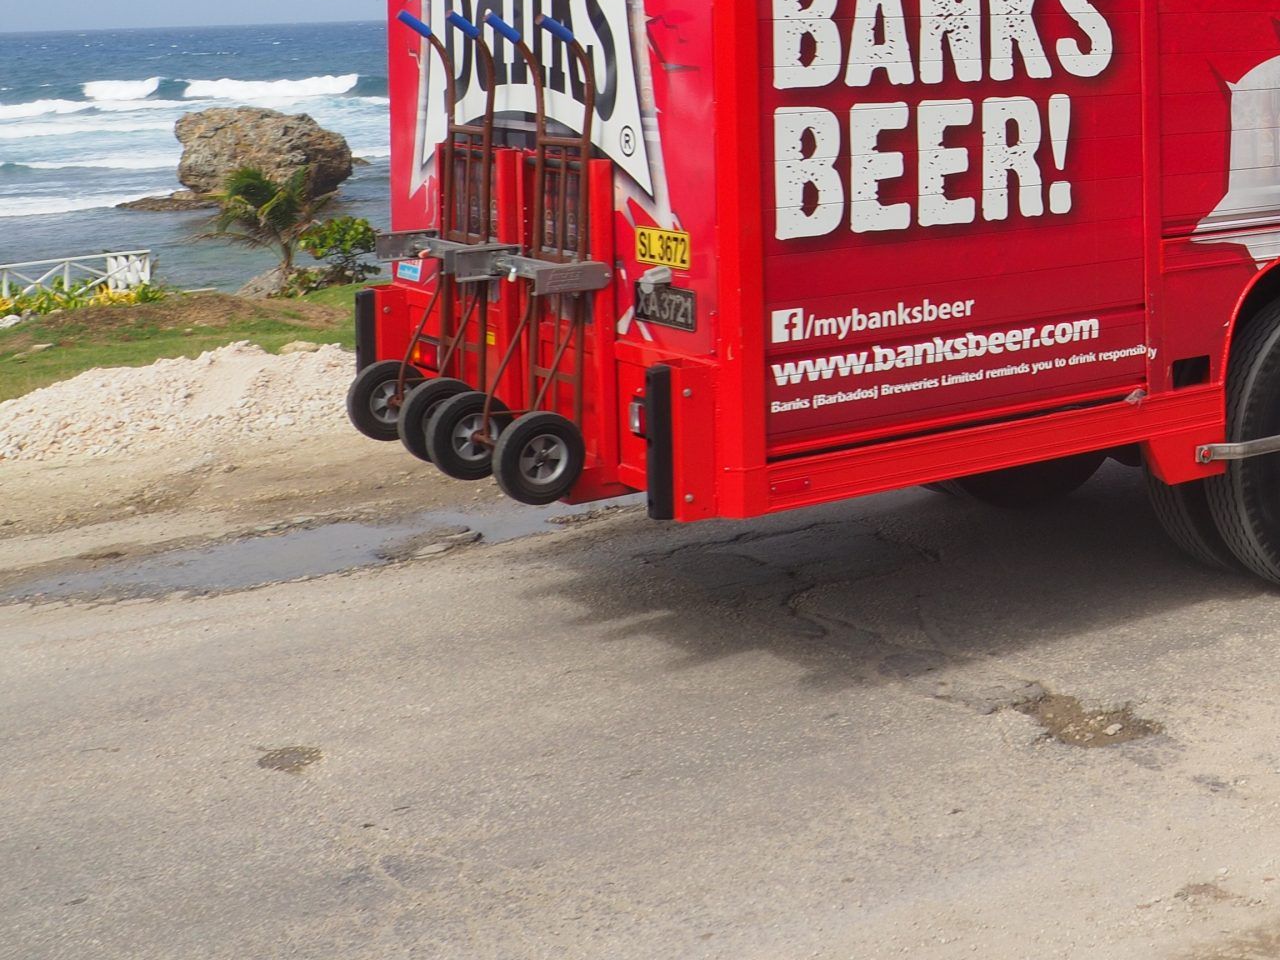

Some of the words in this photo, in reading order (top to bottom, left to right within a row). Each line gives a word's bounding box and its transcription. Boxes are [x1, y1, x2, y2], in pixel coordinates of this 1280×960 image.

[773, 93, 1072, 241] BEER!
[638, 231, 656, 259] SL
[657, 234, 687, 264] 3672
[770, 317, 1100, 387] www.banksbeer.com
[770, 397, 811, 414] Banks
[812, 385, 879, 410] (Barbados)
[880, 377, 940, 396] Breweries
[940, 368, 984, 386] Limited
[985, 362, 1030, 380] reminds
[1031, 359, 1053, 375] you
[1054, 357, 1067, 368] to
[1068, 351, 1097, 367] drink
[1098, 343, 1158, 362] responsibly
